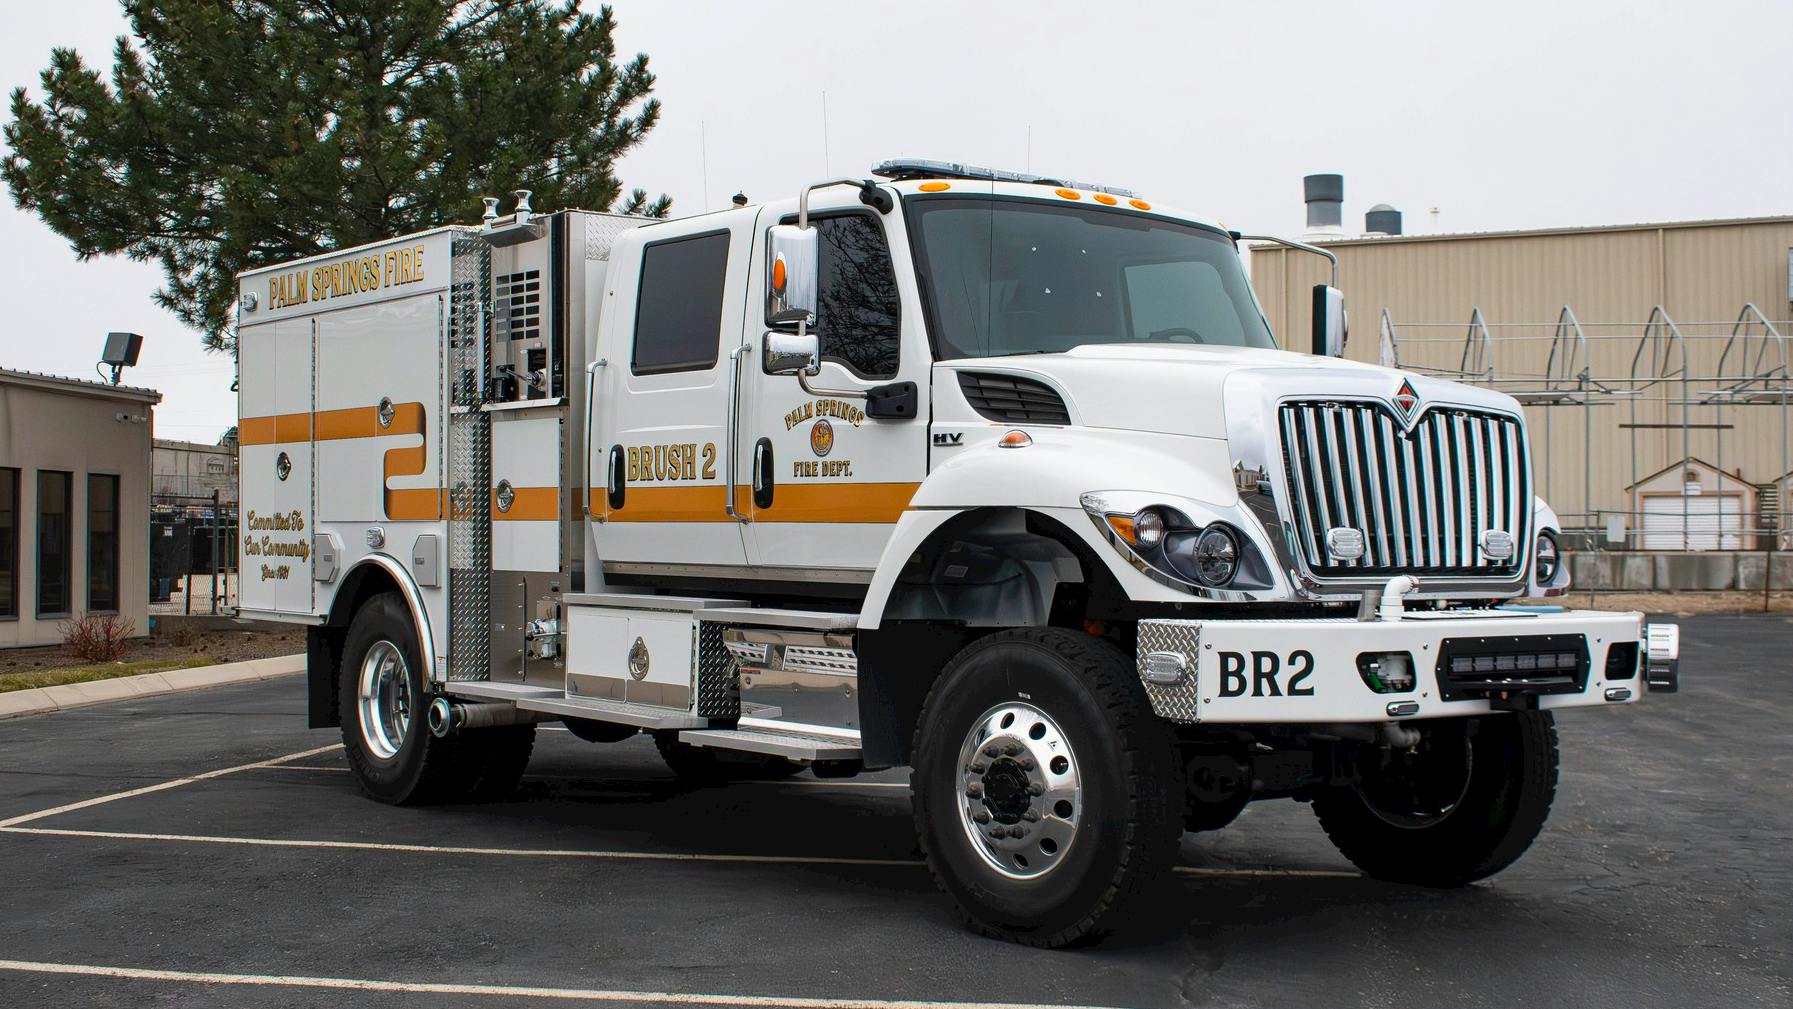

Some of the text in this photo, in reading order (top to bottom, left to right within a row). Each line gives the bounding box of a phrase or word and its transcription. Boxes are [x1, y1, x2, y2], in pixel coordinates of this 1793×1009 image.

[269, 245, 424, 310] PALM SPRINGS FIRE
[784, 399, 865, 431] PALM SPRINGS
[933, 432, 963, 443] HV
[627, 442, 717, 481] BRUSH 2
[793, 460, 853, 477] FIRE DEPT.
[247, 510, 305, 531] Committed To
[261, 535, 310, 563] Community
[1217, 649, 1315, 697] BR2
